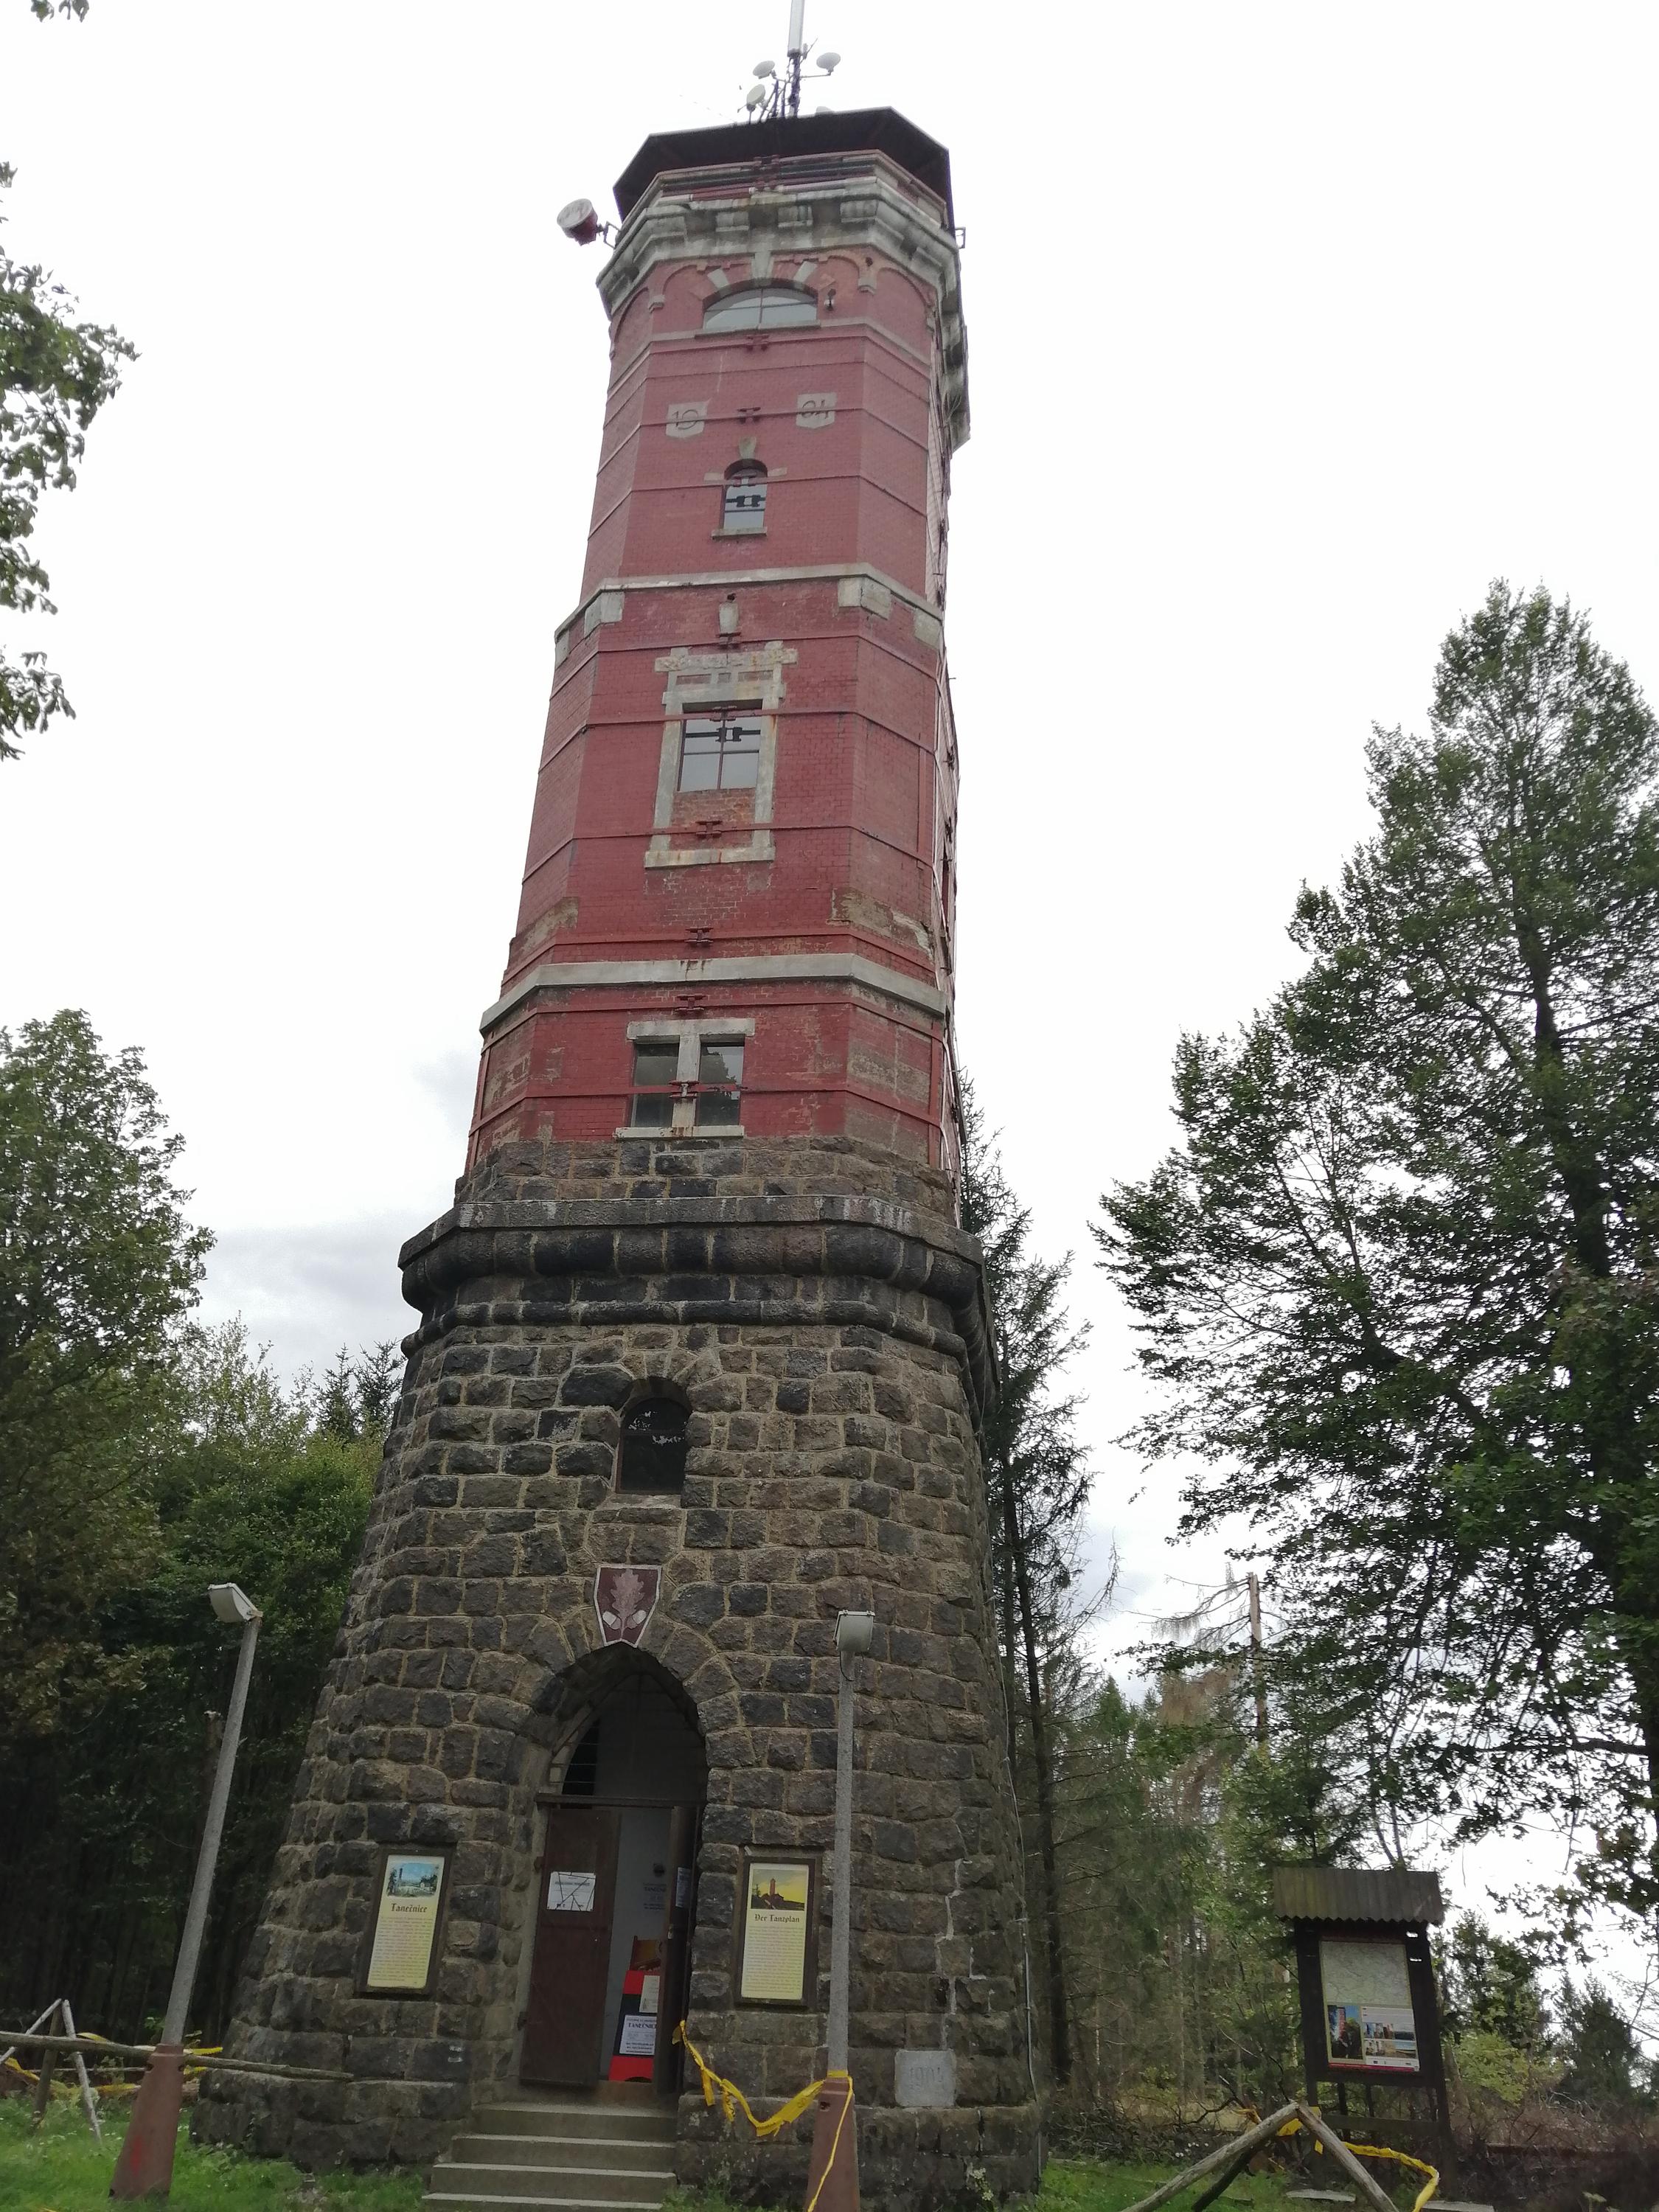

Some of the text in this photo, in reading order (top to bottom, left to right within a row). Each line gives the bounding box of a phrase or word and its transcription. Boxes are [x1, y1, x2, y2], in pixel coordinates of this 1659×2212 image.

[391, 1902, 428, 1913] Tanečnice
[754, 1913, 800, 1923] Der Tanzplan
